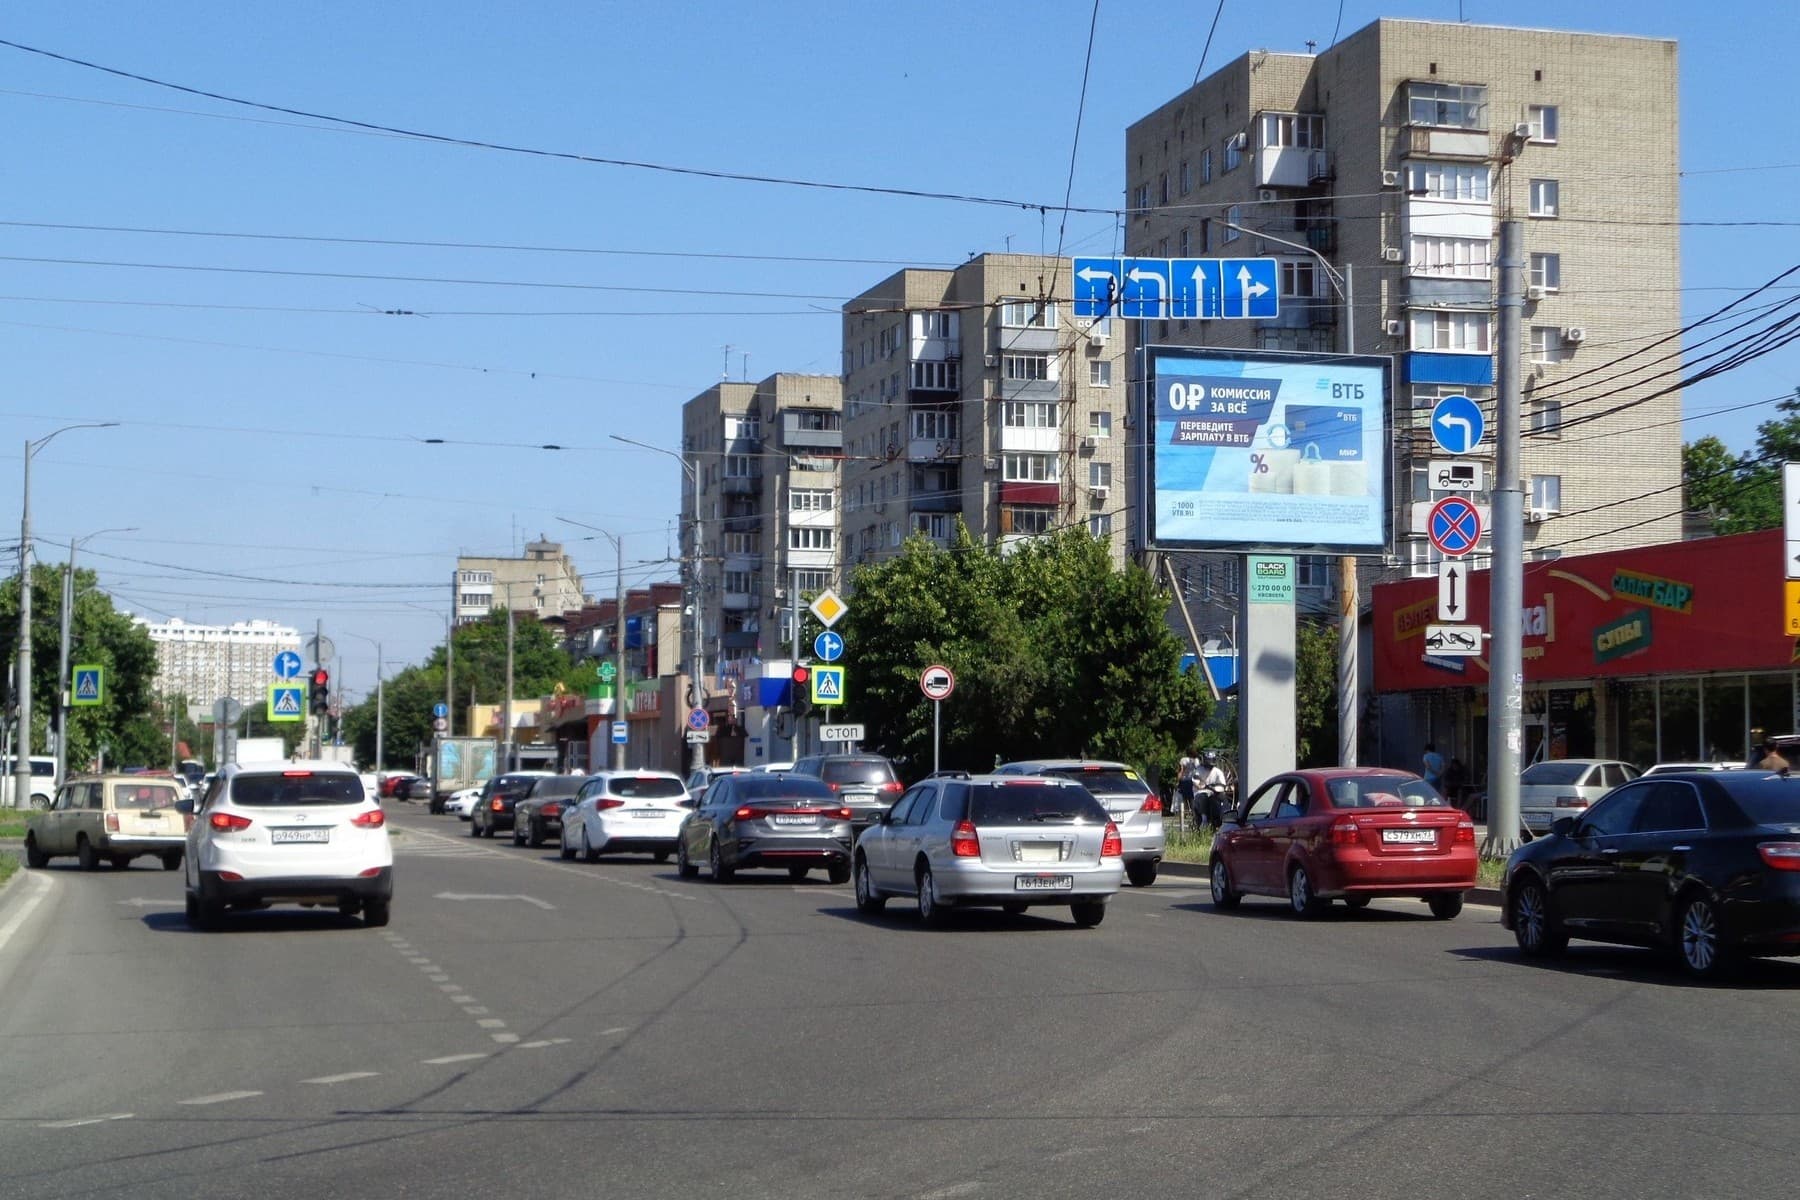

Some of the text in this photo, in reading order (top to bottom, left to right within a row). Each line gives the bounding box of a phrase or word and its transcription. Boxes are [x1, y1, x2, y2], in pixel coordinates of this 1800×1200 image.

[1210, 387, 1271, 401] КОМИССИЯ
[1332, 383, 1364, 399] ВТБ
[1210, 400, 1248, 414] ЗА ВСЁ
[1180, 421, 1234, 432] ПЕРЕВЕДИТЕ
[1180, 432, 1249, 443] ЗАРПЛАТУ В ВТБ
[1250, 453, 1269, 474] %
[1652, 581, 1688, 610] БАР
[1597, 620, 1642, 651] СУПЫ
[826, 727, 858, 739] СТОП
